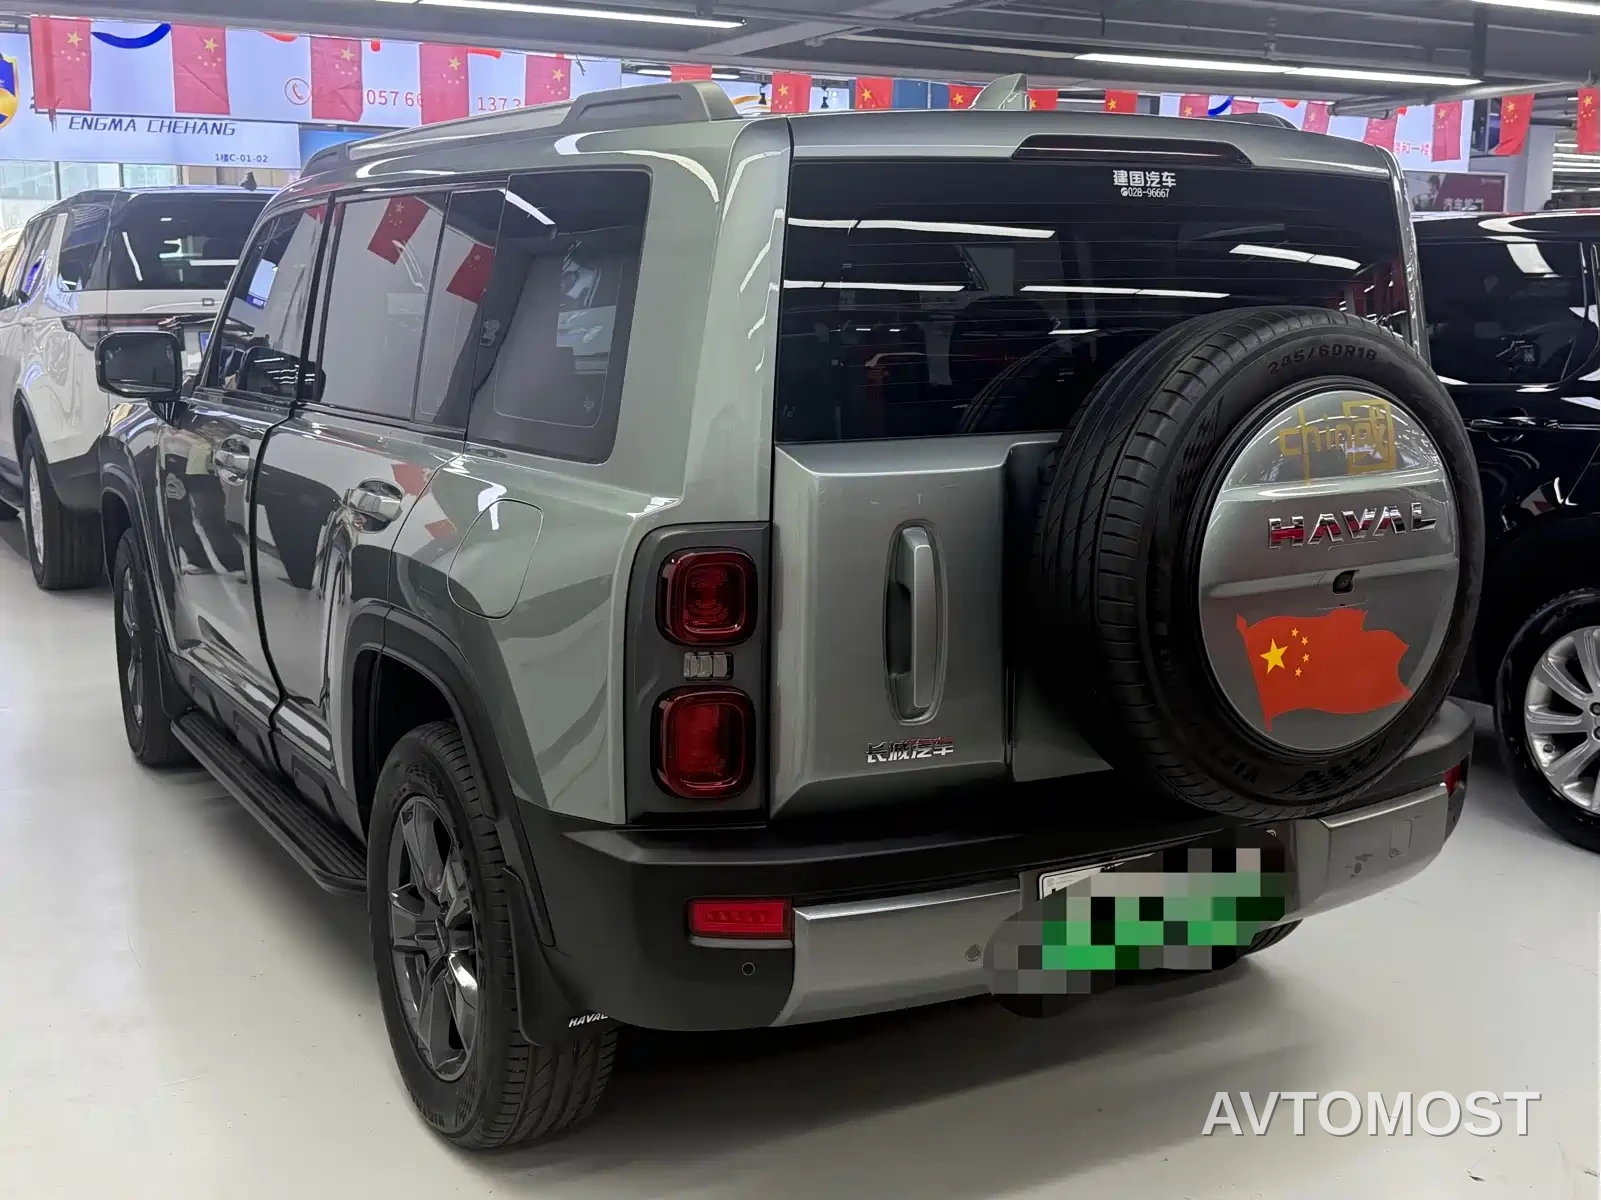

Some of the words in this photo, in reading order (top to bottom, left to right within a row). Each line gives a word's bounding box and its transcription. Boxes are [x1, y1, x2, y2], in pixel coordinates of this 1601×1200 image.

[68, 116, 137, 132] ENGMA
[147, 119, 237, 136] CHEHANG
[1112, 169, 1177, 188] 建国汽车
[1127, 187, 1170, 198] 028-96667
[1267, 343, 1378, 375] 245/60R18
[1268, 501, 1437, 551] HAVAL
[865, 736, 955, 763] 长城汽车
[568, 1012, 609, 1028] HAVAL
